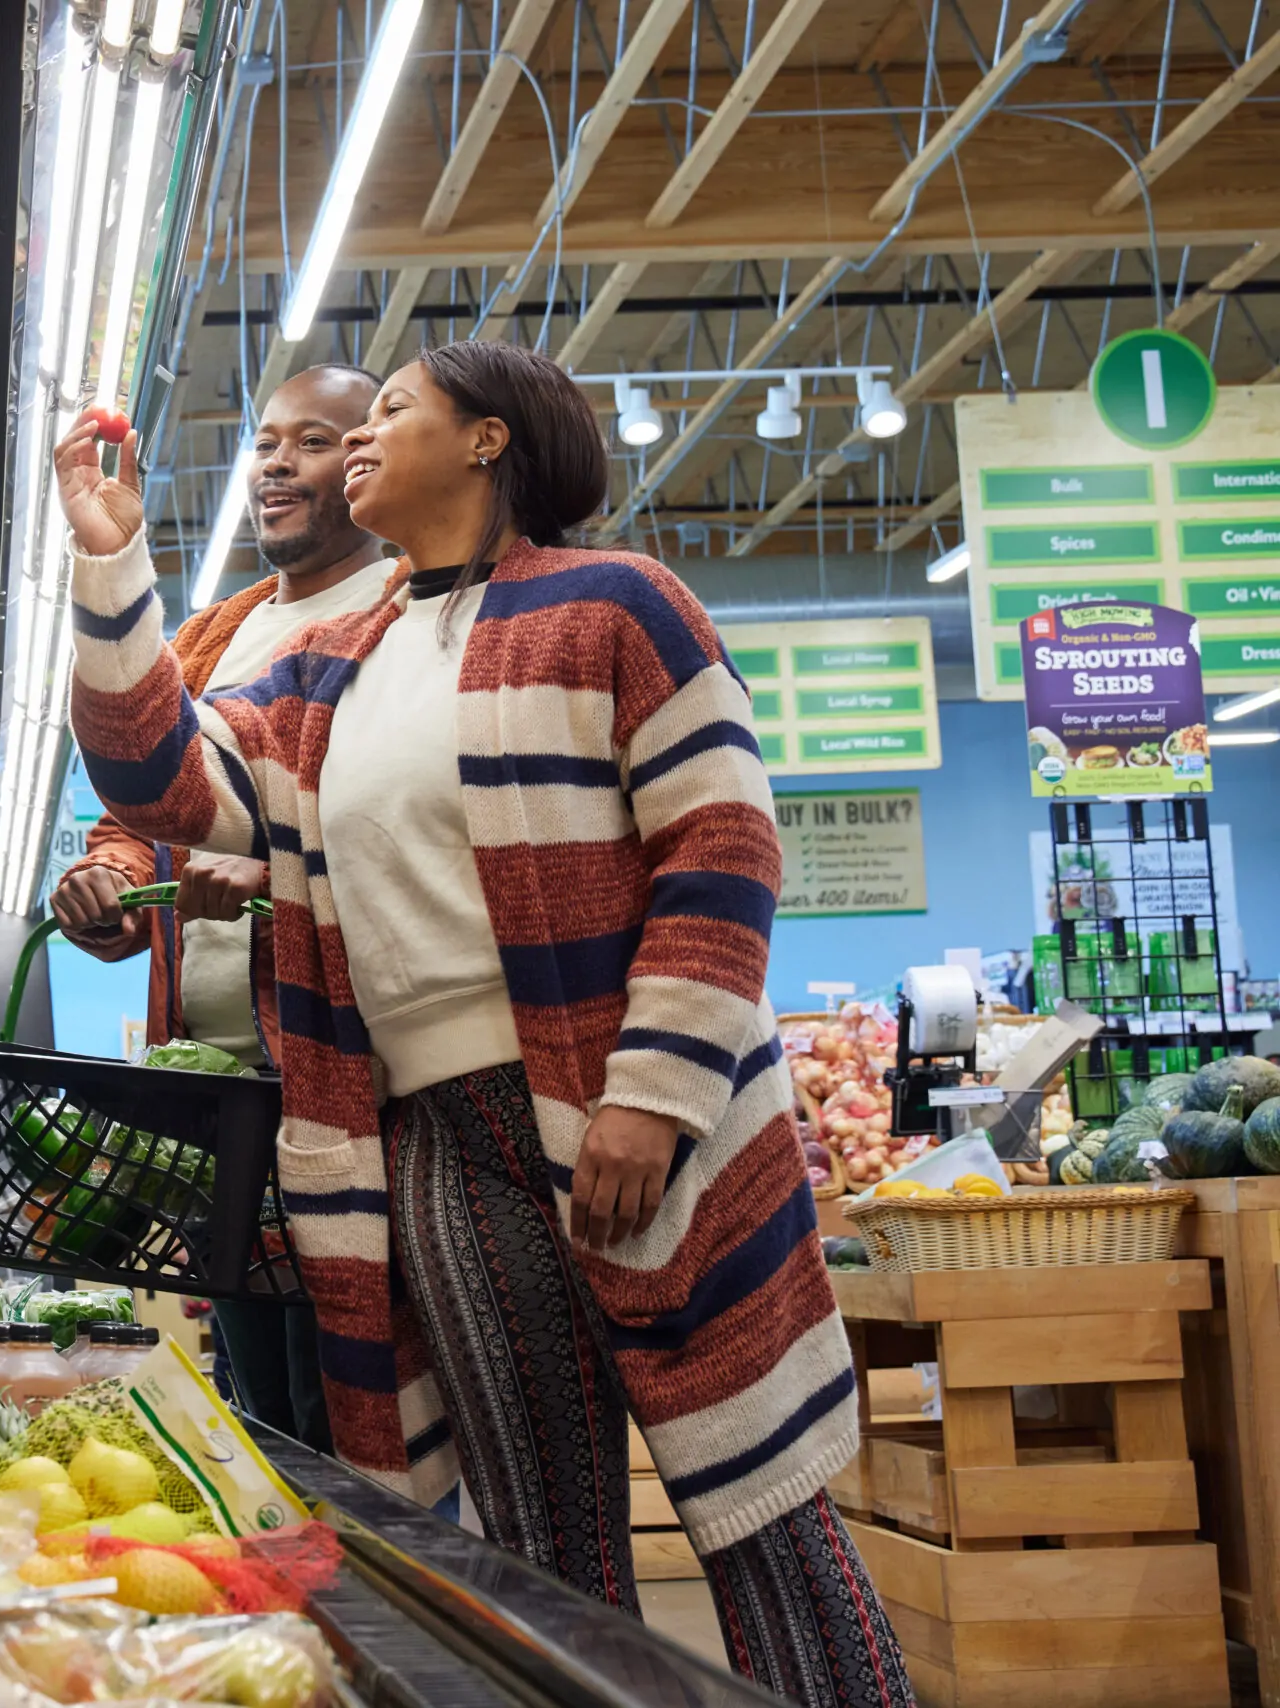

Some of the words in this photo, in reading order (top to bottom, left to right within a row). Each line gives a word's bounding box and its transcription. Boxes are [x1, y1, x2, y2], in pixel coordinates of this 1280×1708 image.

[1050, 477, 1083, 493] Bulk
[1050, 535, 1096, 555] Spices
[1226, 588, 1248, 603] Oil
[1061, 633, 1099, 645] Organic
[1101, 632, 1109, 642] &
[1111, 631, 1157, 642] Non-GMO
[1034, 646, 1188, 670] SPROUTING
[1073, 672, 1154, 696] SEEDS
[828, 696, 858, 708] Local
[821, 739, 851, 751] Local
[814, 802, 836, 825] IN
[845, 799, 913, 825] BULK?
[816, 888, 849, 906] 400
